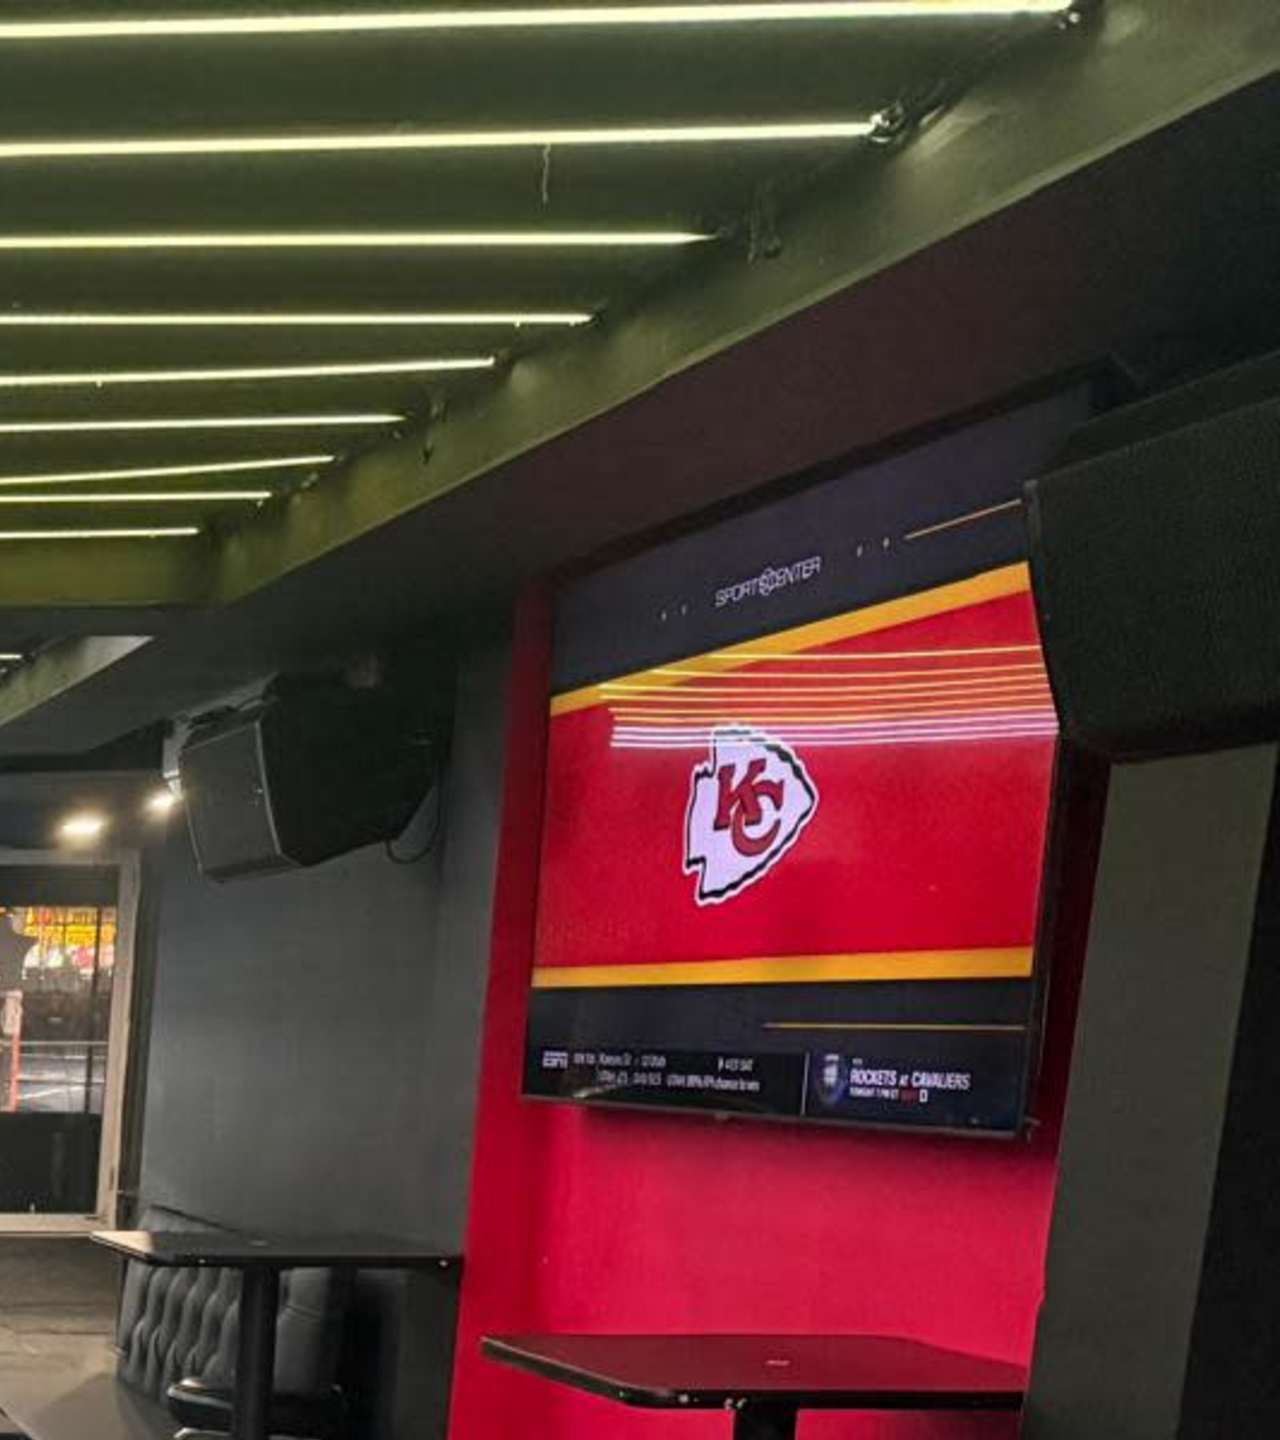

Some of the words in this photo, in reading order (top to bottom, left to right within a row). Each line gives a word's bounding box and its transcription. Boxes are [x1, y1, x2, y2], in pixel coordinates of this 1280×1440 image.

[713, 758, 784, 857] KC
[542, 1051, 568, 1069] ESPN
[850, 1068, 897, 1086] ROCKETS
[911, 1071, 971, 1089] CAVALIERS
